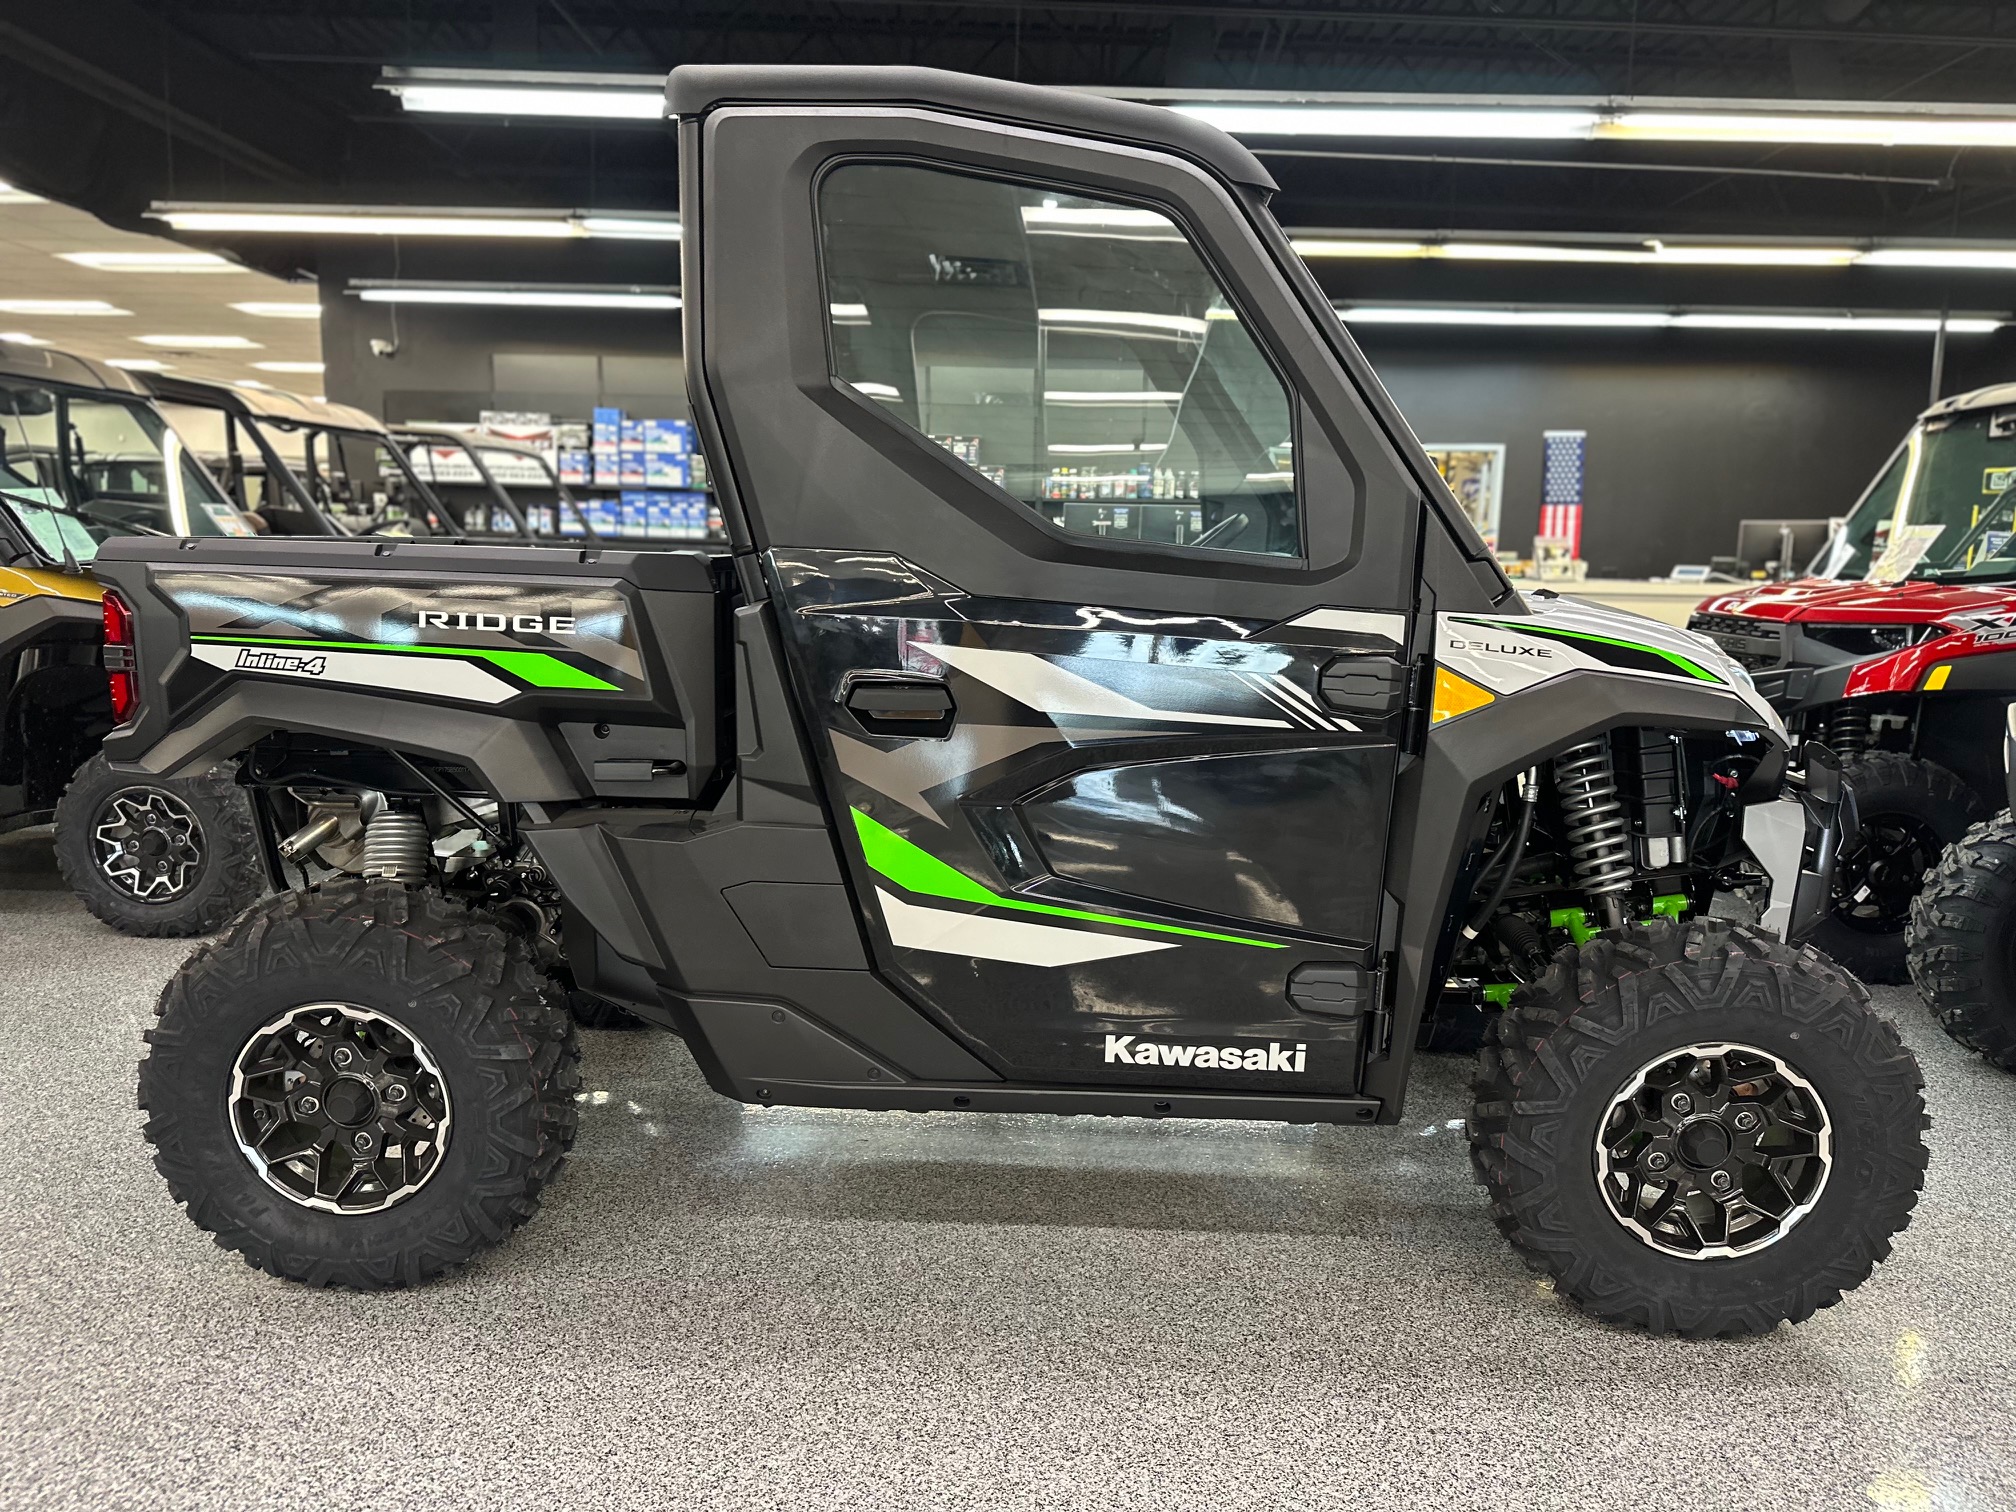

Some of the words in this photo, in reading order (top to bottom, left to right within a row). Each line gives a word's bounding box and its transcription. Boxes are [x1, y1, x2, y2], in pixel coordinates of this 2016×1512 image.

[418, 610, 576, 635] RIDGE
[1449, 640, 1553, 658] DELUXE
[235, 649, 327, 675] Inline-4
[1104, 1034, 1307, 1073] Kawasaki
